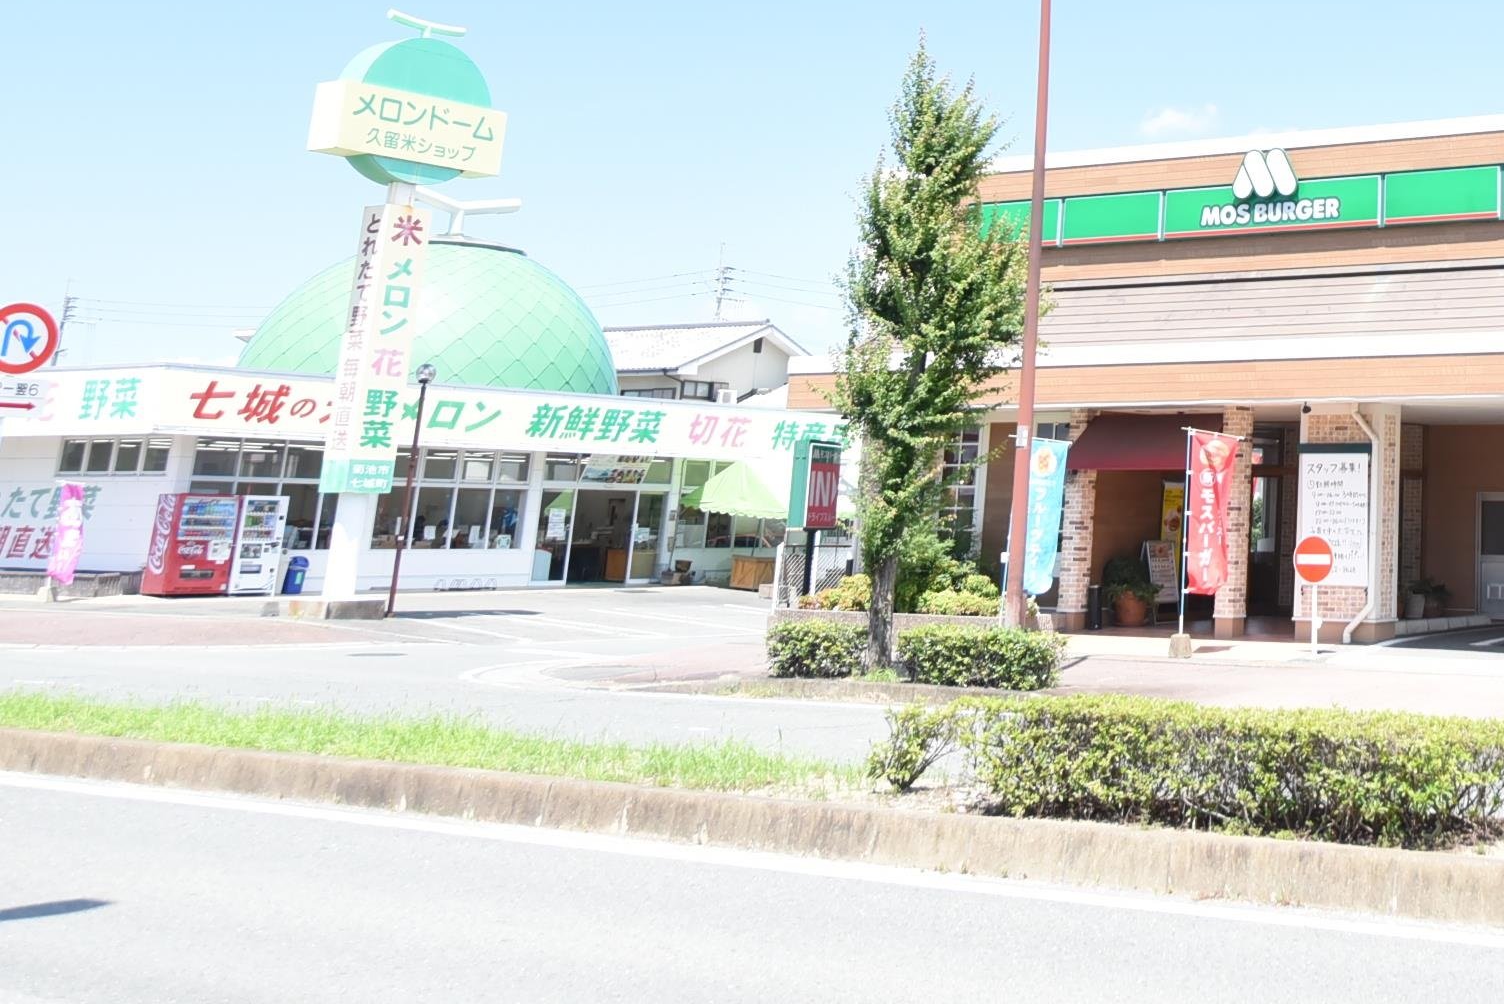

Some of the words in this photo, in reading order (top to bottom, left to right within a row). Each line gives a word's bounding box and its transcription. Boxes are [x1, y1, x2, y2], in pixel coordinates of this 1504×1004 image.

[352, 94, 494, 142] メロンドーム
[366, 127, 477, 162] 久留米ショップ
[391, 215, 423, 246] 米
[1201, 204, 1250, 226] MOS
[1254, 198, 1340, 223] BURGER
[379, 258, 413, 335] メロン
[371, 348, 404, 378] 花
[78, 377, 142, 420] 野菜
[360, 389, 399, 448] 野菜
[525, 403, 667, 444] 新鮮野菜
[689, 413, 752, 447] 切花
[1199, 489, 1215, 583] モスバーガー
